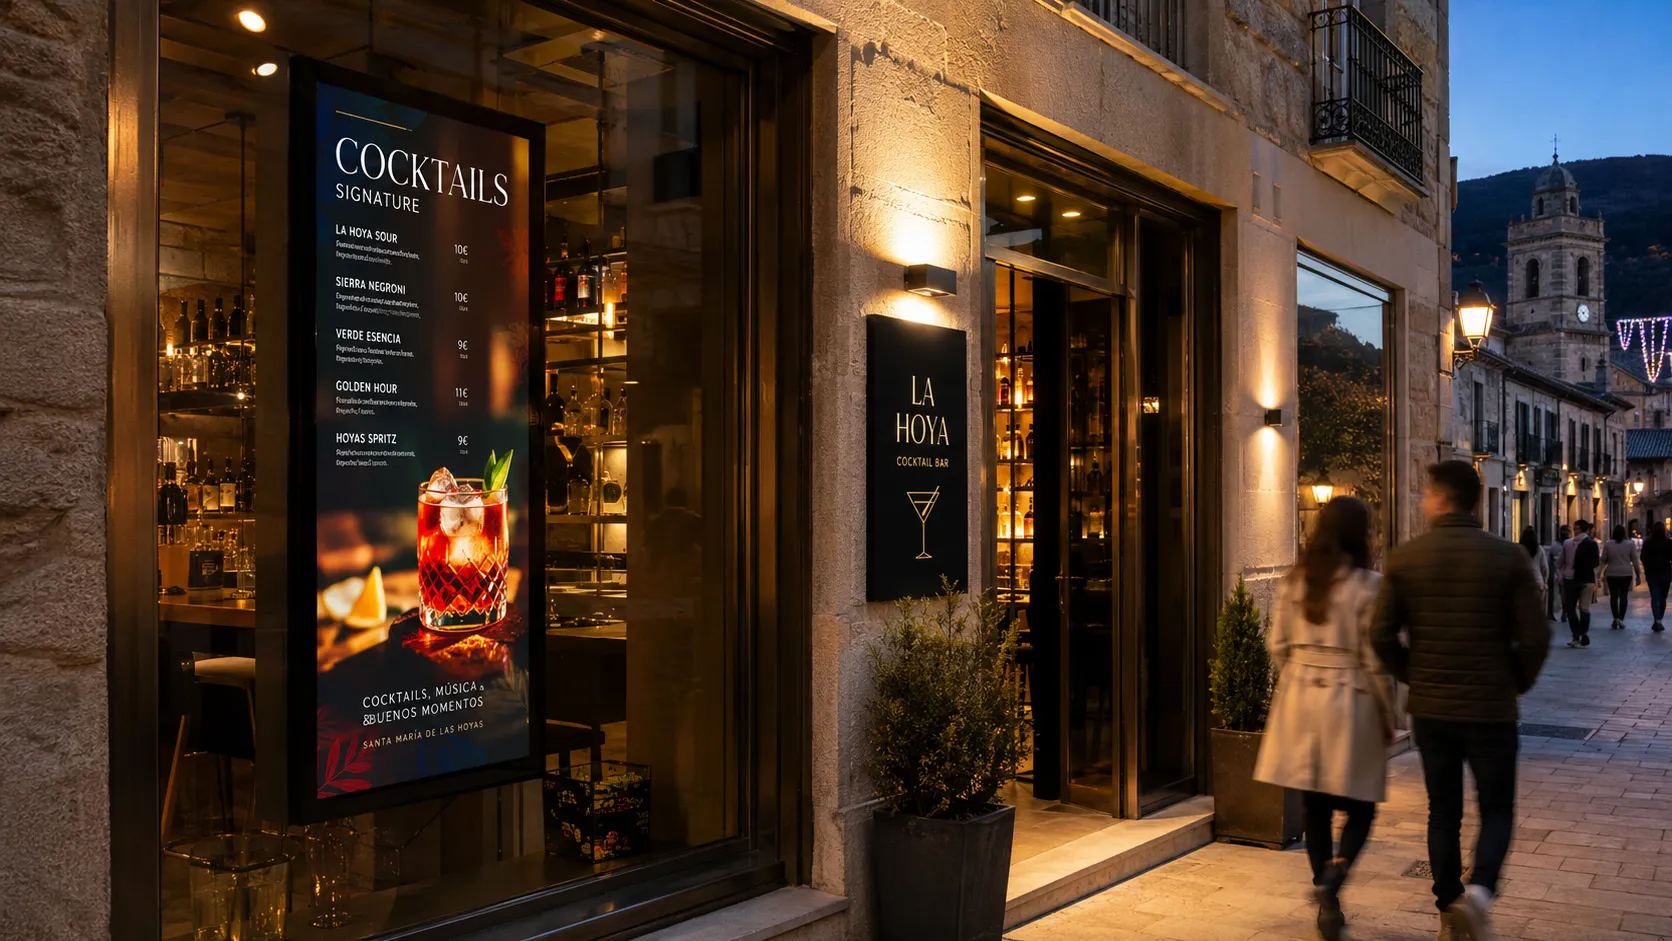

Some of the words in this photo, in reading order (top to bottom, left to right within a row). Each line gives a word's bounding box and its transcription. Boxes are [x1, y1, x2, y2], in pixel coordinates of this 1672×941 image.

[335, 137, 509, 207] COCKTAILS
[335, 183, 420, 214] SIGNATURE
[335, 224, 347, 236] LA
[349, 226, 373, 240] HOYA
[375, 230, 398, 244] SOUR
[454, 244, 468, 255] 10€
[335, 276, 367, 290] SIERRA
[368, 280, 406, 295] NEGRONI
[454, 292, 468, 303] 10€
[335, 328, 364, 341] VERDE
[366, 330, 401, 344] ESENCIA
[457, 340, 468, 350] 9€
[335, 380, 371, 393] GOLDEN
[373, 383, 398, 394] HOUR
[455, 387, 468, 398] 11€
[912, 375, 935, 407] LA
[896, 412, 949, 446] HOYA
[335, 432, 366, 444] HOYAS
[368, 433, 397, 444] SPRITZ
[457, 435, 468, 445] 9€
[896, 456, 933, 467] COCKTAIL
[935, 458, 949, 467] BAR
[362, 688, 431, 708] COCKTAILS,
[435, 681, 477, 697] MÚSICA
[421, 696, 484, 716] MOMENTOS
[363, 737, 392, 750] SANTA
[395, 729, 423, 743] MARÍA
[425, 729, 436, 738] DE
[439, 725, 455, 735] LAS
[457, 720, 484, 732] HOYAS
